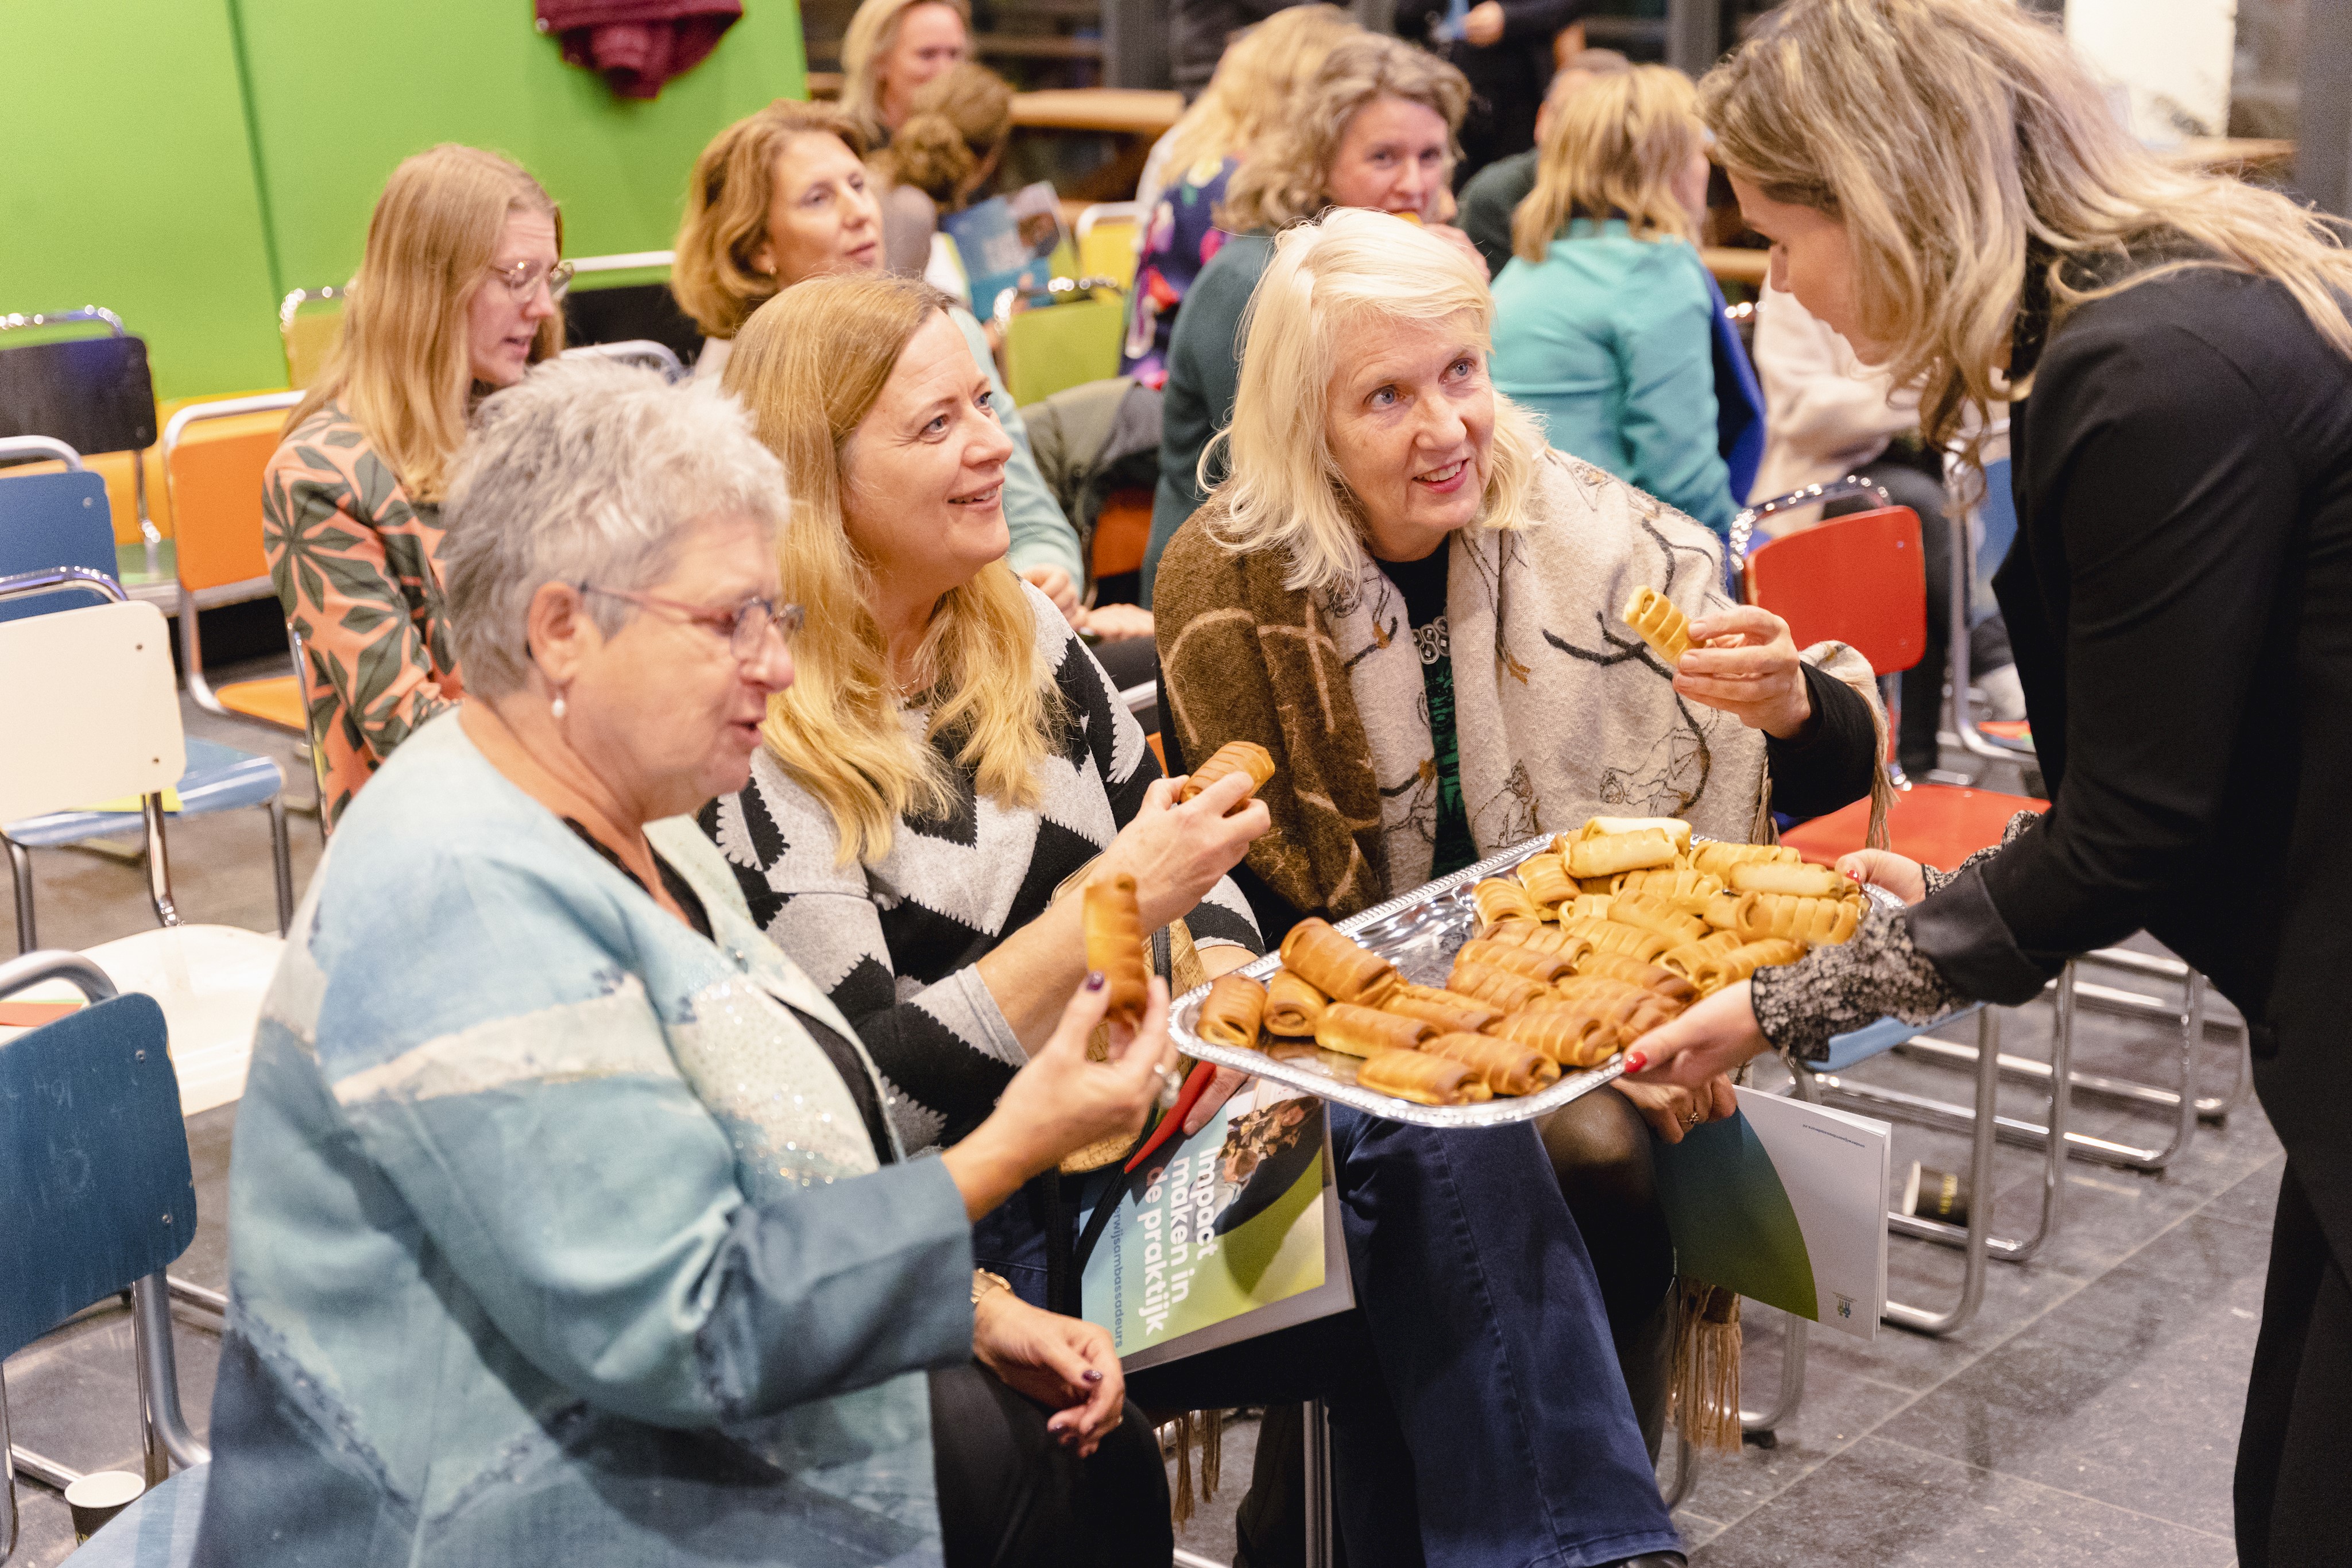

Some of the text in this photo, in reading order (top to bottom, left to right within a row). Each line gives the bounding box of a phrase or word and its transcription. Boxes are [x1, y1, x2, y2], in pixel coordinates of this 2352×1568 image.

[1189, 1146, 1221, 1260] Impact
[1802, 1124, 1865, 1148] onderwijsambassadeurs.nl
[1111, 1202, 1124, 1348] erwijsambassadeurs
[1137, 1167, 1170, 1336] de praktijk
[1170, 1156, 1195, 1303] maken in
